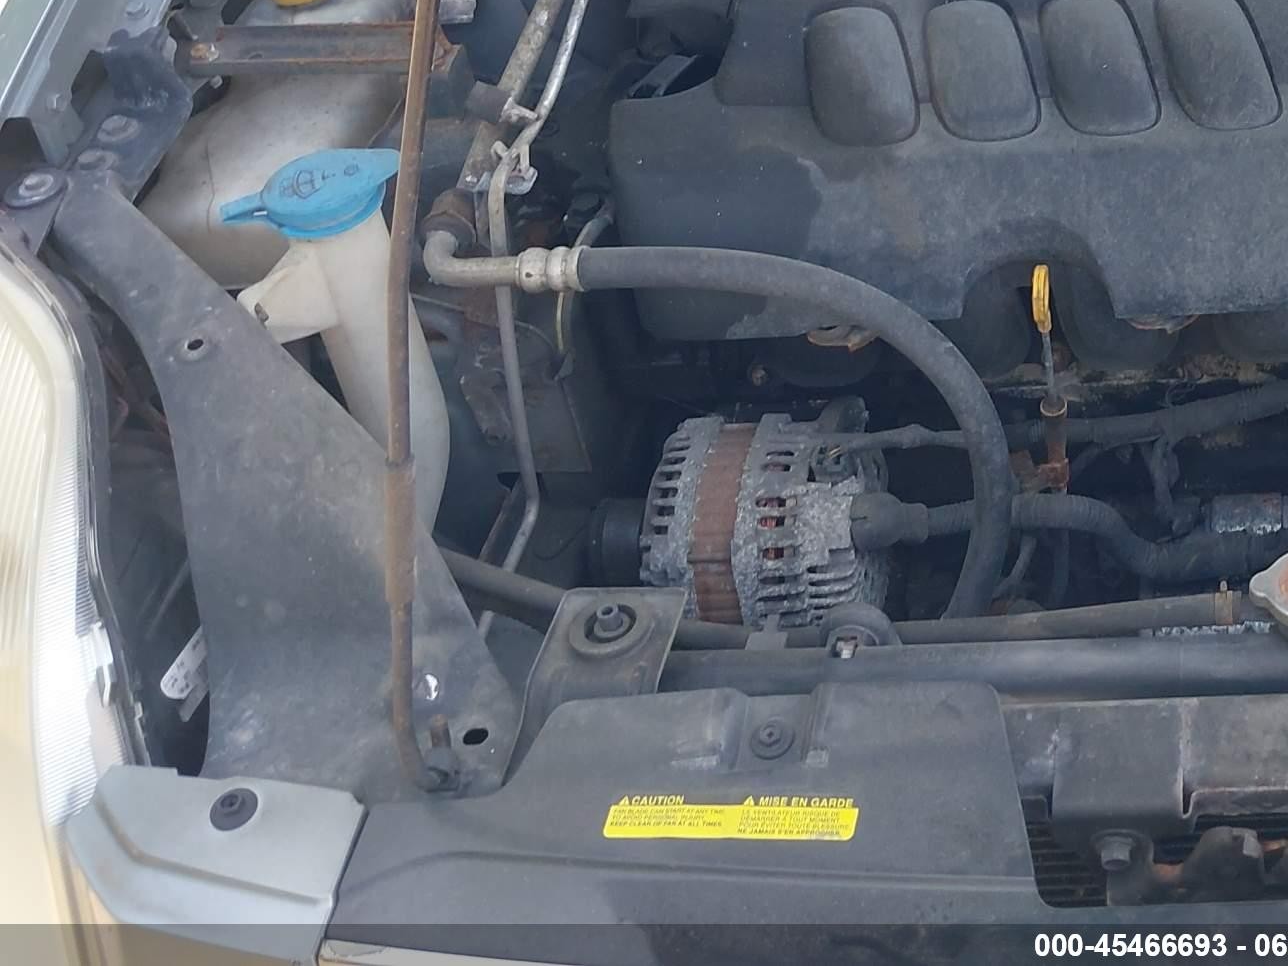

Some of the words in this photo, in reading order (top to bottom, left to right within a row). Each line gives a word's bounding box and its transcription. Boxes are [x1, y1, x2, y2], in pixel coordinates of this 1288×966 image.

[631, 795, 684, 806] CAUTION
[758, 796, 788, 807] MISE
[790, 796, 809, 807] EN
[810, 797, 855, 808] GARDE
